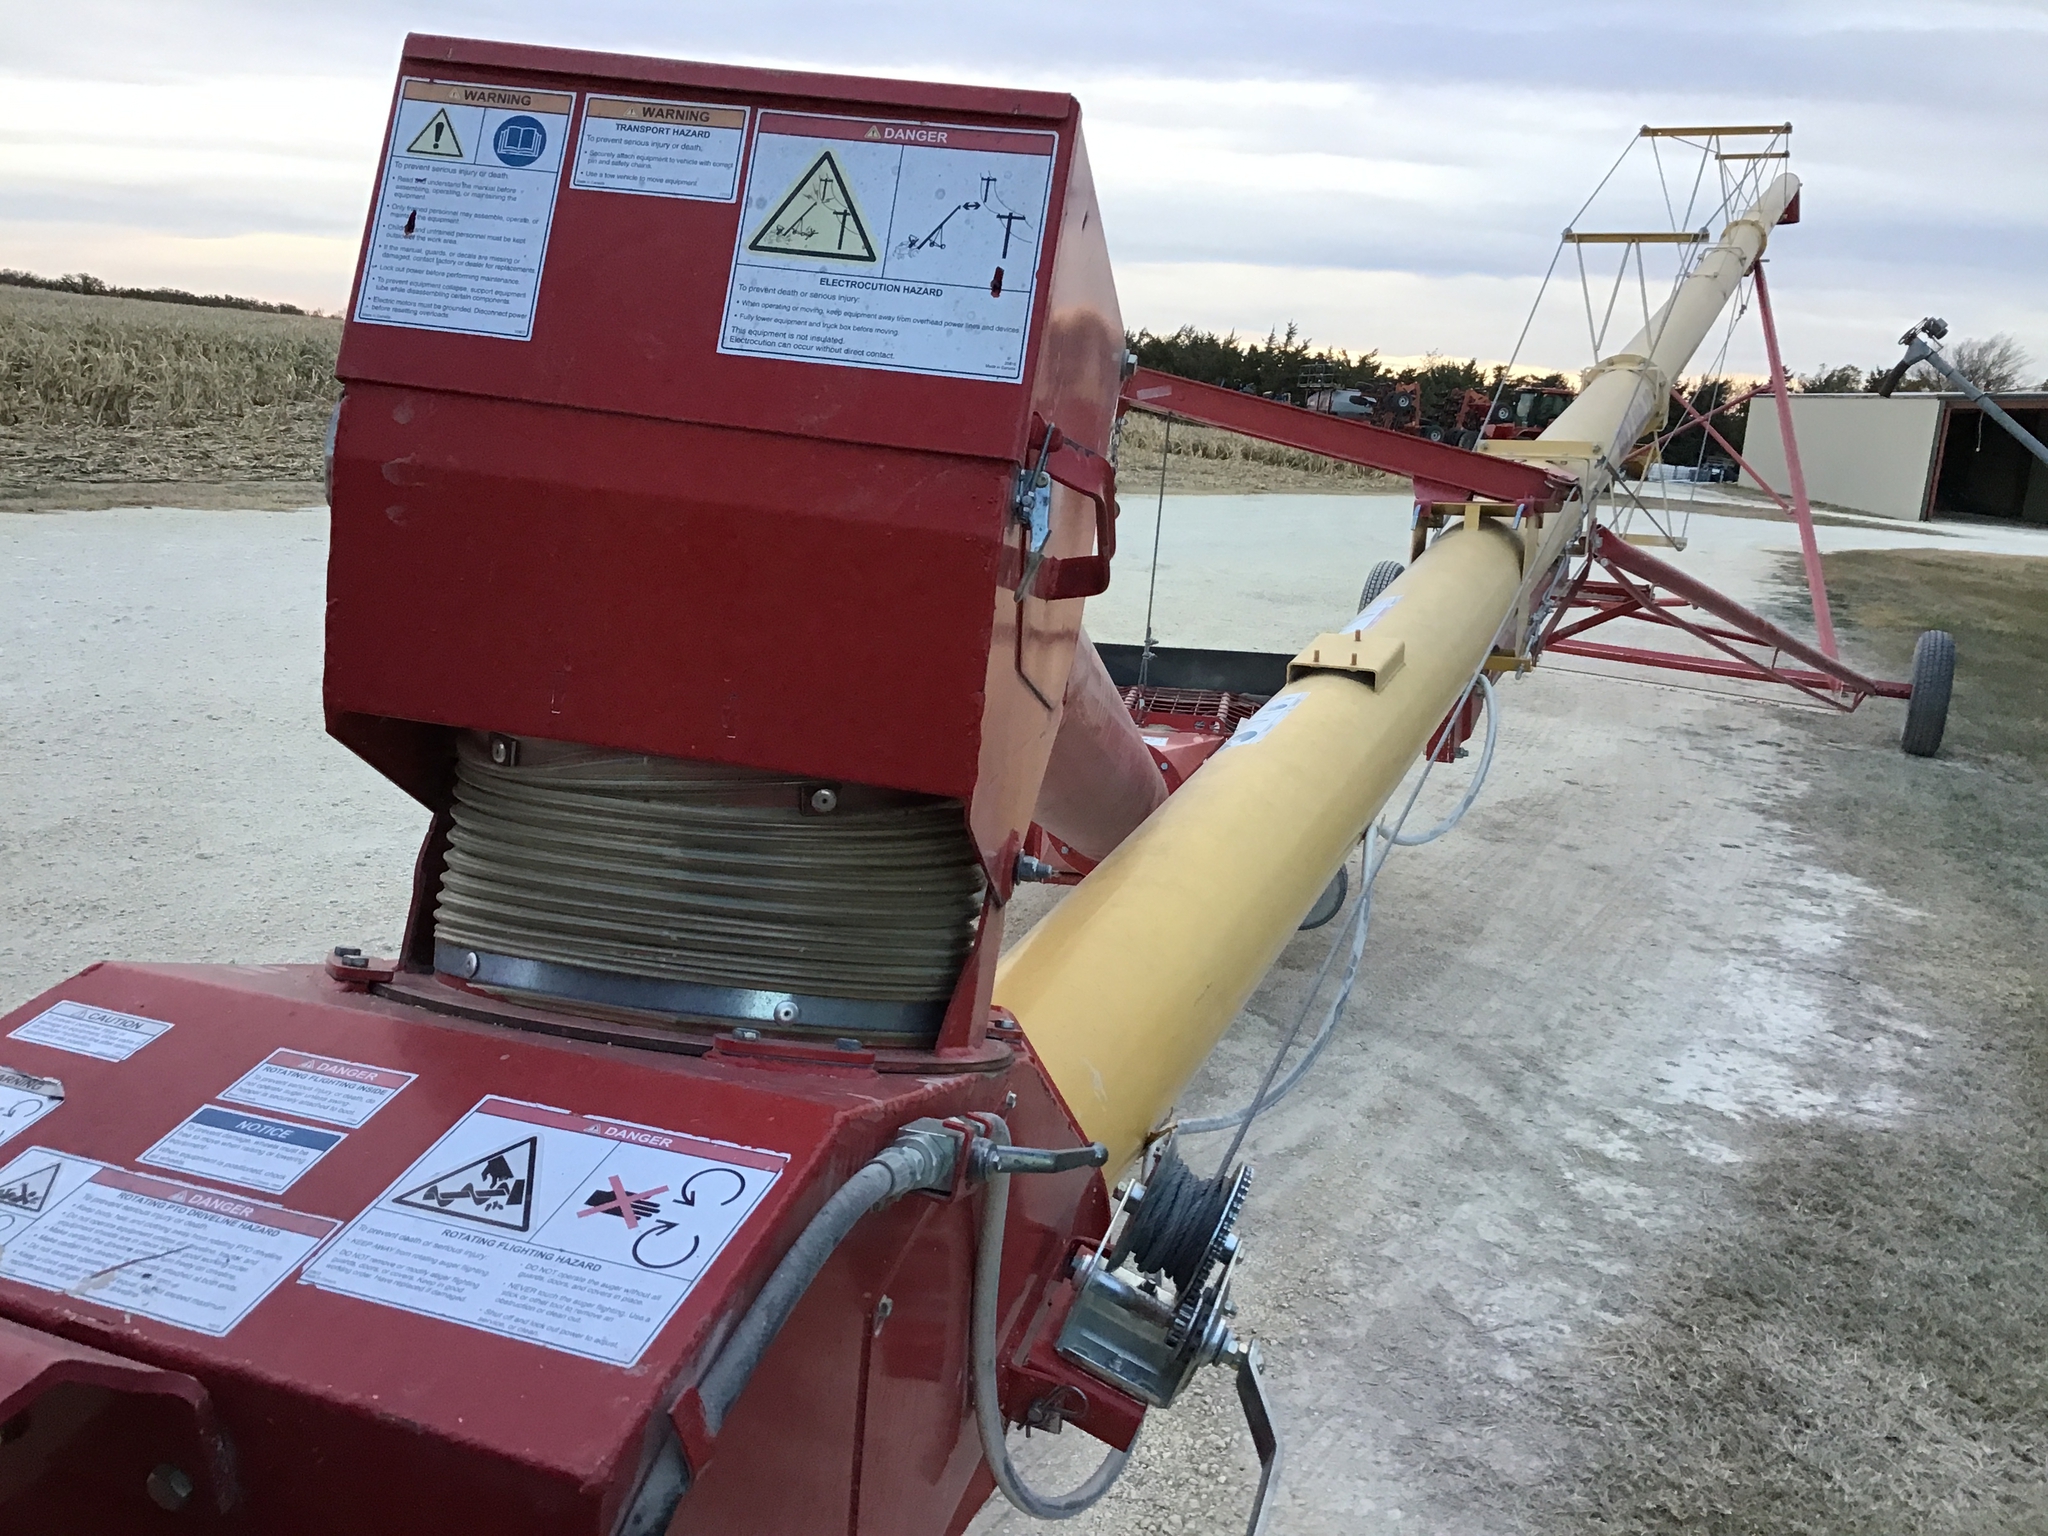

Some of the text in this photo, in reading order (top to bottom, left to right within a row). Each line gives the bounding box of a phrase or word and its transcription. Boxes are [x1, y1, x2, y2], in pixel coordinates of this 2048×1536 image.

[463, 89, 532, 105] WARNING
[641, 106, 710, 122] WARNING
[616, 123, 710, 138] TRANSPORT HAZARD
[883, 127, 948, 143] DANGER
[595, 136, 622, 144] prevent
[650, 140, 670, 149] injury
[589, 150, 615, 159] Securely
[636, 154, 668, 162] equipment
[747, 285, 776, 293] prevent
[777, 288, 798, 296] death
[809, 292, 836, 300] serious
[819, 277, 942, 296] ELECTROCUTION HAZARD
[761, 302, 790, 311] operating
[826, 308, 842, 316] keep
[843, 311, 877, 319] equipment
[878, 314, 895, 322] away
[739, 313, 754, 321] Fully
[773, 317, 807, 325] equipment
[852, 324, 873, 332] before
[731, 325, 746, 334] This
[747, 327, 786, 339] equipment
[729, 335, 776, 347] Electrocution
[815, 344, 842, 353] without
[843, 347, 864, 356] direct
[87, 1013, 142, 1029] CAUTION
[262, 1066, 387, 1095] ROTATING FLIGHTING INSIDE
[316, 1063, 378, 1081] DANGER
[0, 1074, 43, 1090] ARNING
[235, 1120, 293, 1138] NOTICE
[603, 1126, 673, 1148] DANGER
[116, 1192, 280, 1236] ROTATING PTO DRIVELINE HAZARD
[188, 1194, 254, 1217] DANGER
[441, 1229, 601, 1271] ROTATING FLIGHTING HAZARD
